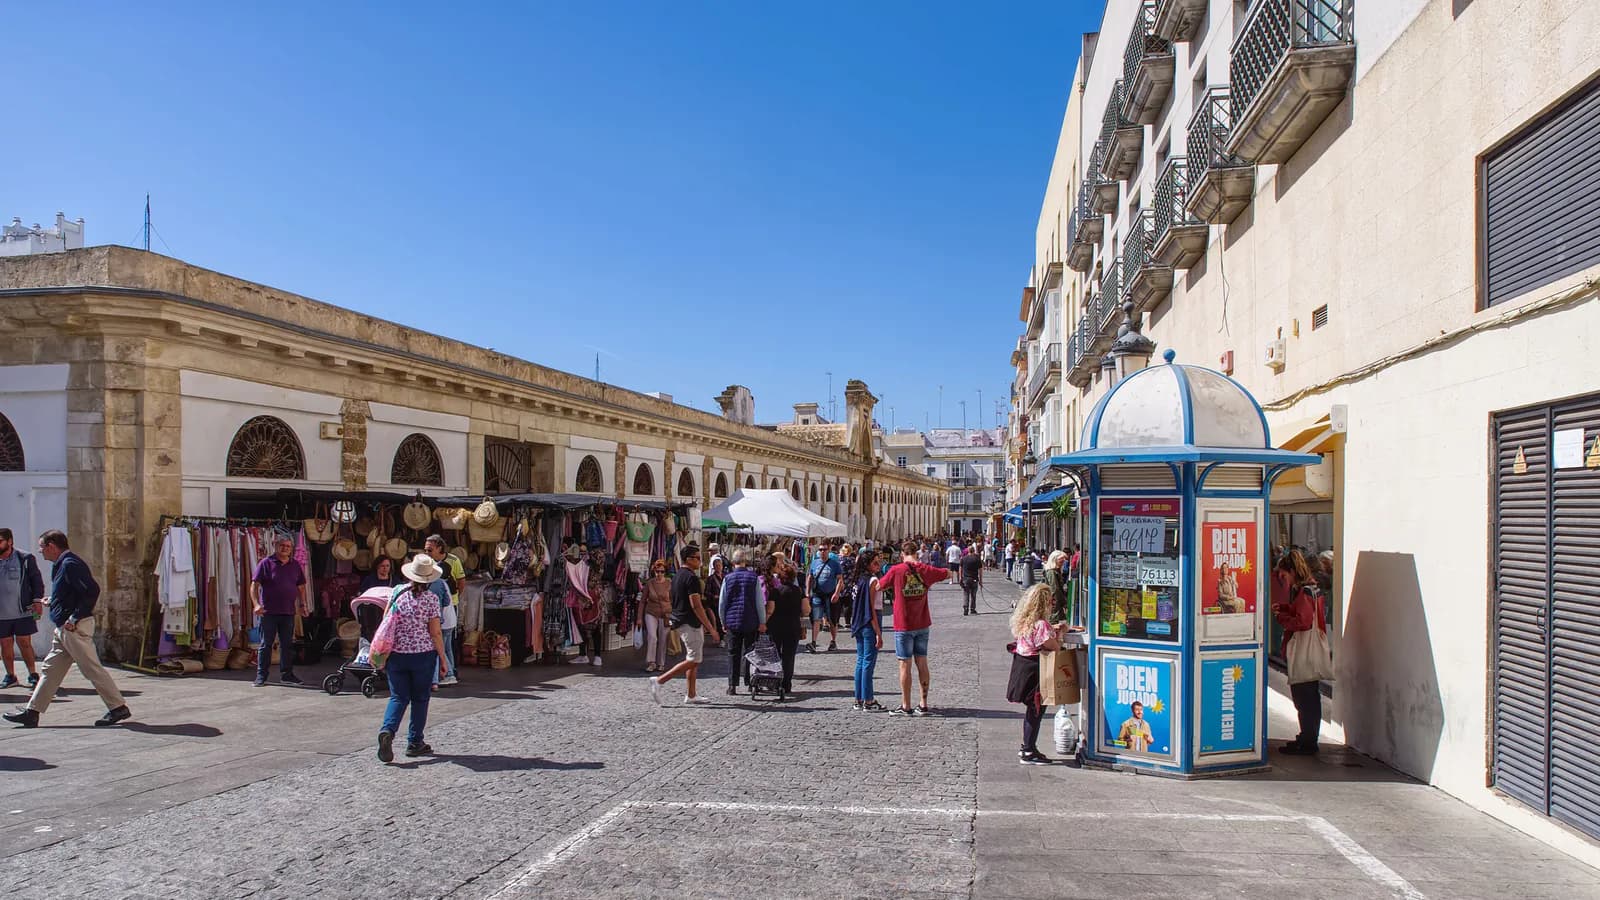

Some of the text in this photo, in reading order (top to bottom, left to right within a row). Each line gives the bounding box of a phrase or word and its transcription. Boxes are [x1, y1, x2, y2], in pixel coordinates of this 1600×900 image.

[1212, 528, 1246, 554] BIEN
[1213, 554, 1246, 570] JUGADO
[1142, 569, 1176, 580] 76113
[1116, 664, 1158, 692] BIEN
[1116, 690, 1158, 707] JUGADO
[1221, 667, 1235, 741] BIEN JUGADO
